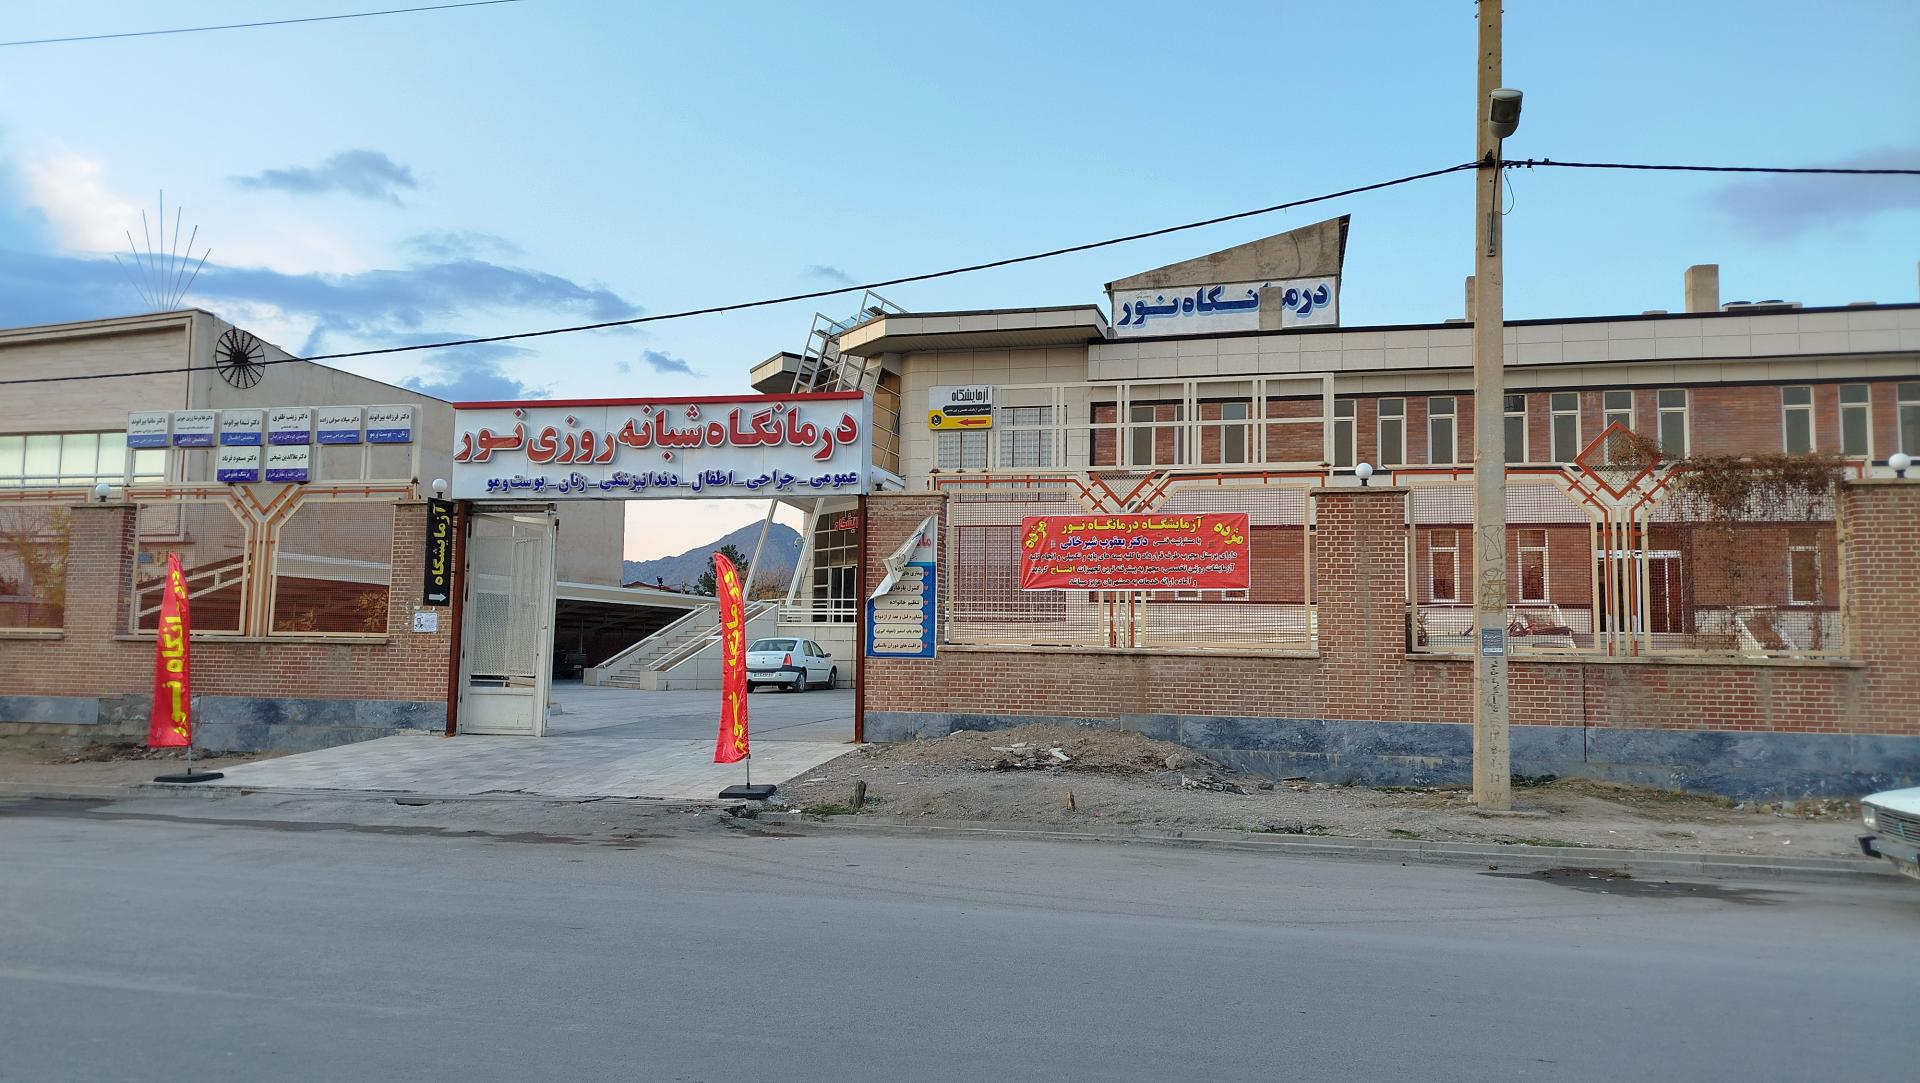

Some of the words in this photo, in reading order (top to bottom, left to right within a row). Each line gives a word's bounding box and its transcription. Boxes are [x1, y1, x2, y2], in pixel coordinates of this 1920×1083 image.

[1182, 281, 1331, 316] درمنگاه
[1116, 294, 1180, 328] نور
[951, 386, 989, 403] آزمایشگاه
[453, 408, 525, 463] نور
[524, 416, 617, 464] روزی
[616, 404, 703, 461] شبانه
[704, 402, 859, 462] درمانگاه
[486, 478, 501, 492] مو
[510, 474, 545, 493] پوست
[558, 471, 586, 493] زنان
[600, 471, 678, 492] دندانپزشکی
[691, 469, 734, 492] اطفال
[746, 469, 795, 490] جراحی
[808, 471, 858, 488] عمومی
[1061, 519, 1085, 533] نور
[1087, 518, 1139, 533] درمانگاه
[1141, 515, 1203, 533] آزمایشگاه
[432, 503, 450, 586] آزمایشگاه
[1099, 536, 1126, 549] یعقوب
[1127, 535, 1148, 549] دکتر
